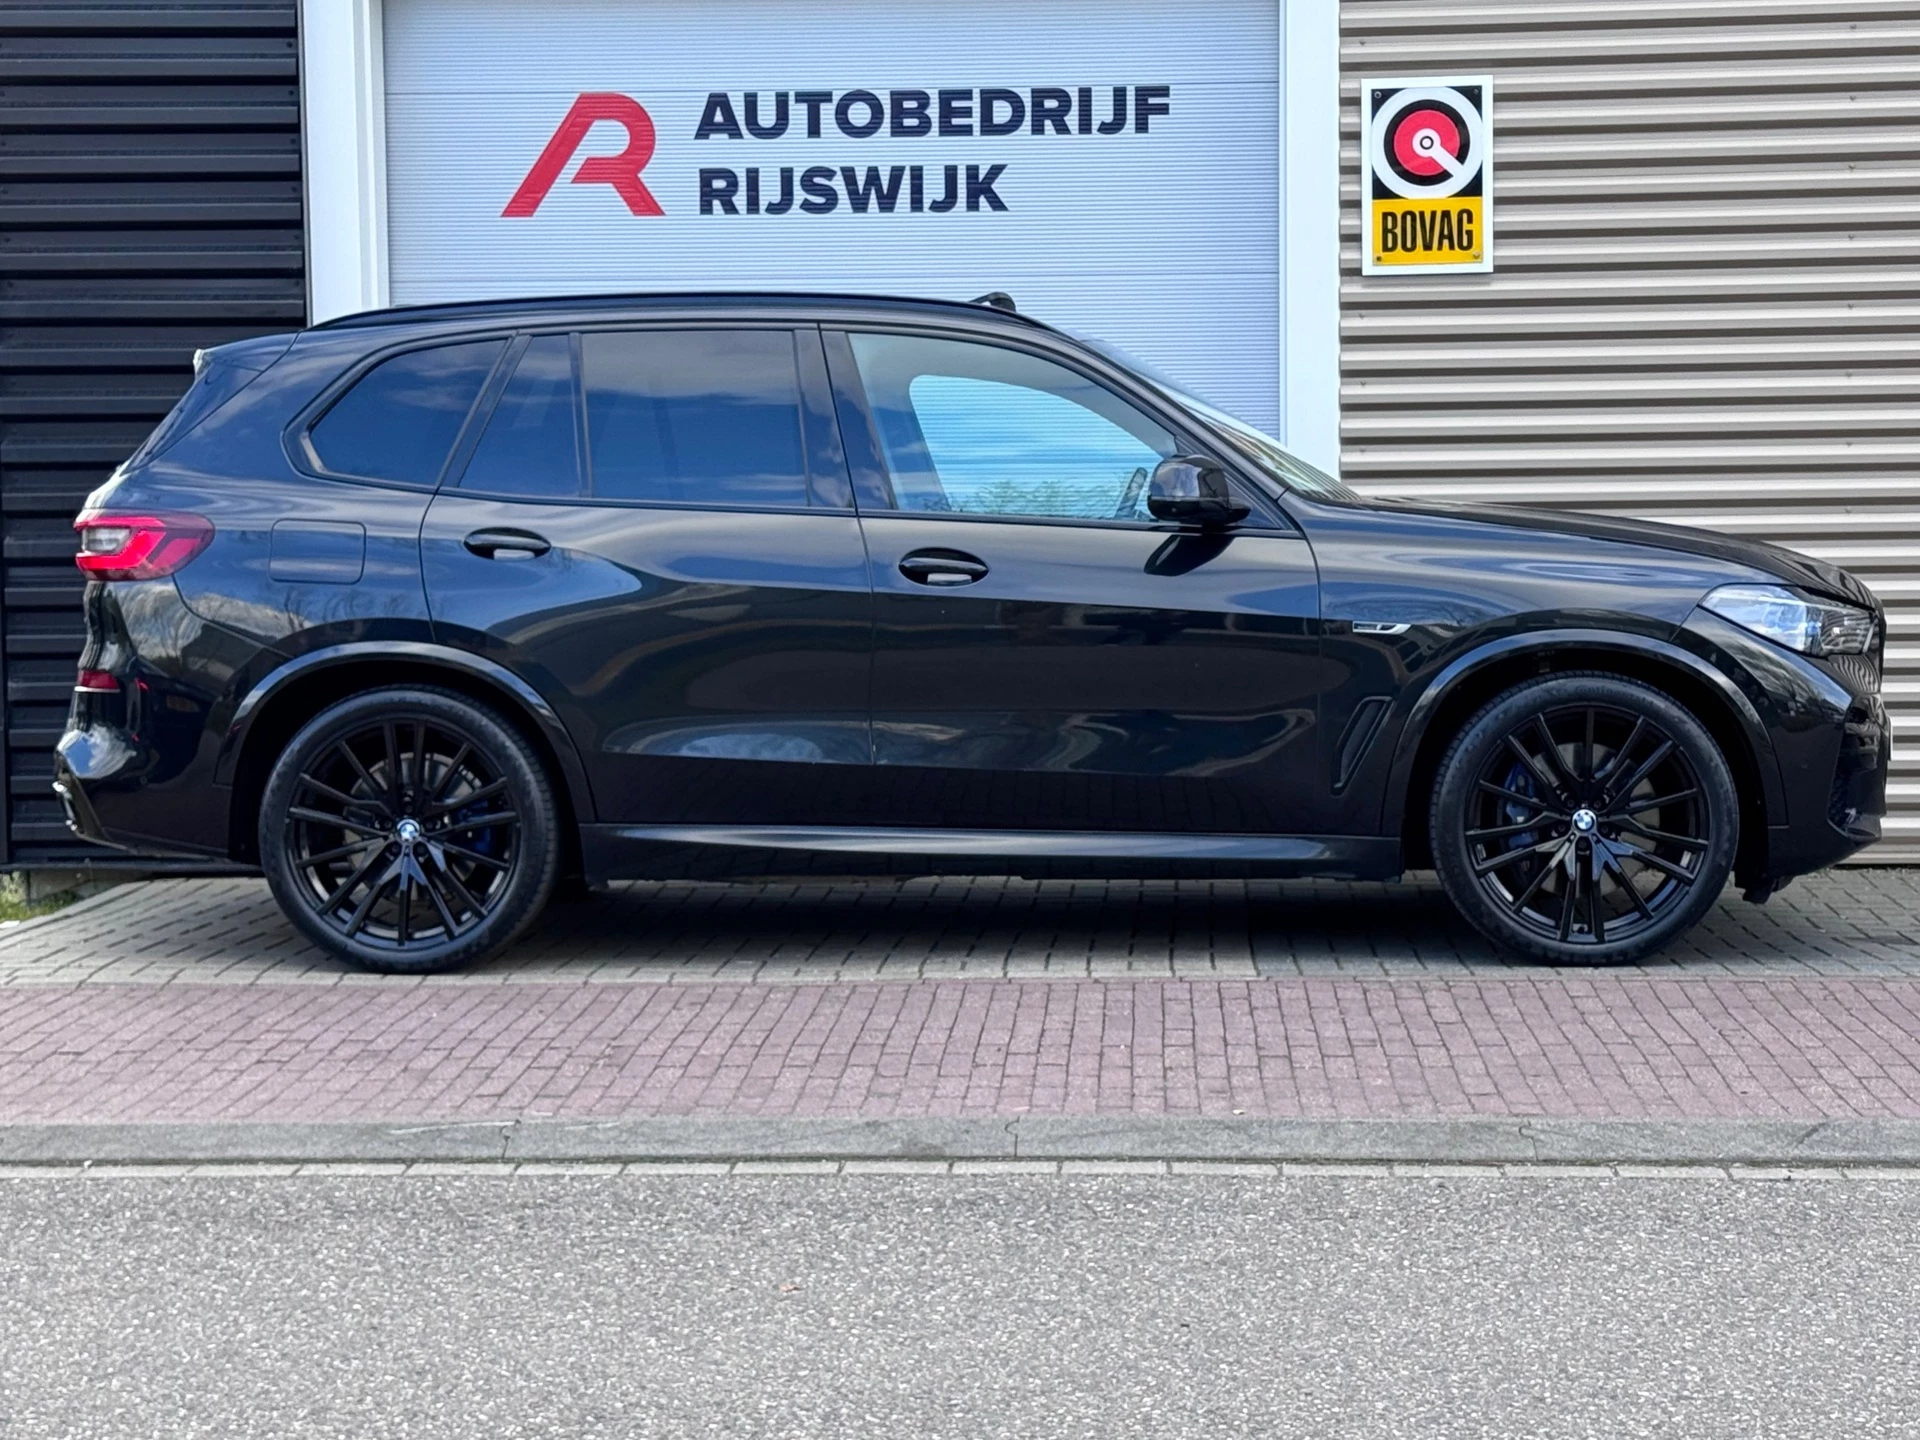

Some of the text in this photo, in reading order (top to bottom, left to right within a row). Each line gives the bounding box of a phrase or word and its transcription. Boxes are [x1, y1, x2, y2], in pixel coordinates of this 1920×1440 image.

[694, 85, 1171, 140] AUTOBEDRIJF
[699, 164, 1009, 215] RIJSWIJK
[1381, 208, 1474, 253] BOVAG
